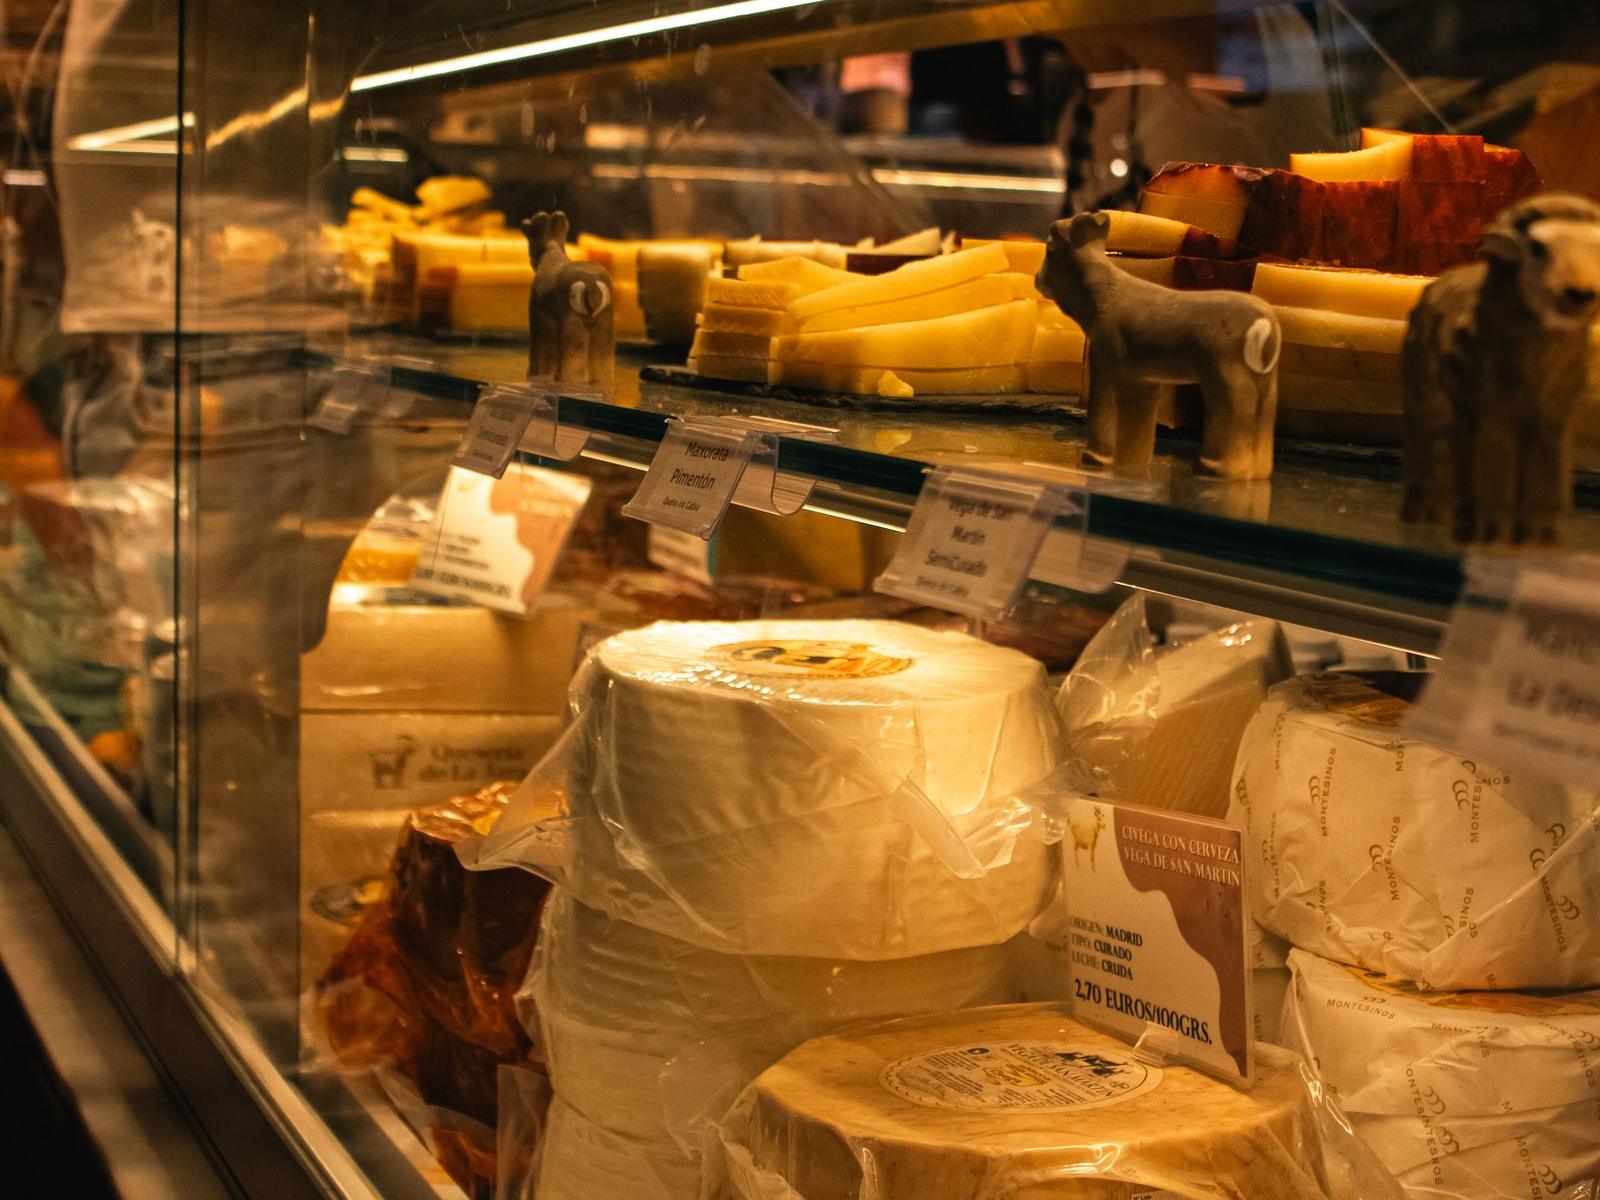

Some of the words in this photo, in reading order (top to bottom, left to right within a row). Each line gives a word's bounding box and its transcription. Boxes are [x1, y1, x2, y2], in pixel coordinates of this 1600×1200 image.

[685, 441, 729, 462] Maxorata
[670, 468, 716, 491] Pimentón
[1320, 747, 1337, 837] MONTESINOS
[1162, 833, 1187, 853] CON
[1189, 839, 1240, 865] CERVEZA
[1384, 816, 1400, 901] MONTESINOS
[1124, 847, 1151, 867] VEGA
[1153, 853, 1169, 871] DE
[1170, 858, 1193, 876] SAN
[1194, 862, 1241, 888] MARTIN
[1541, 876, 1568, 953] MONTESINOS
[1105, 925, 1143, 948] MADRID
[1093, 940, 1132, 962] CURADO
[1101, 960, 1133, 981] CRUDA
[1074, 978, 1102, 1004] 2,70
[1104, 987, 1213, 1046] EUROS/100GRS.
[1327, 999, 1396, 1020] MONTESINOS
